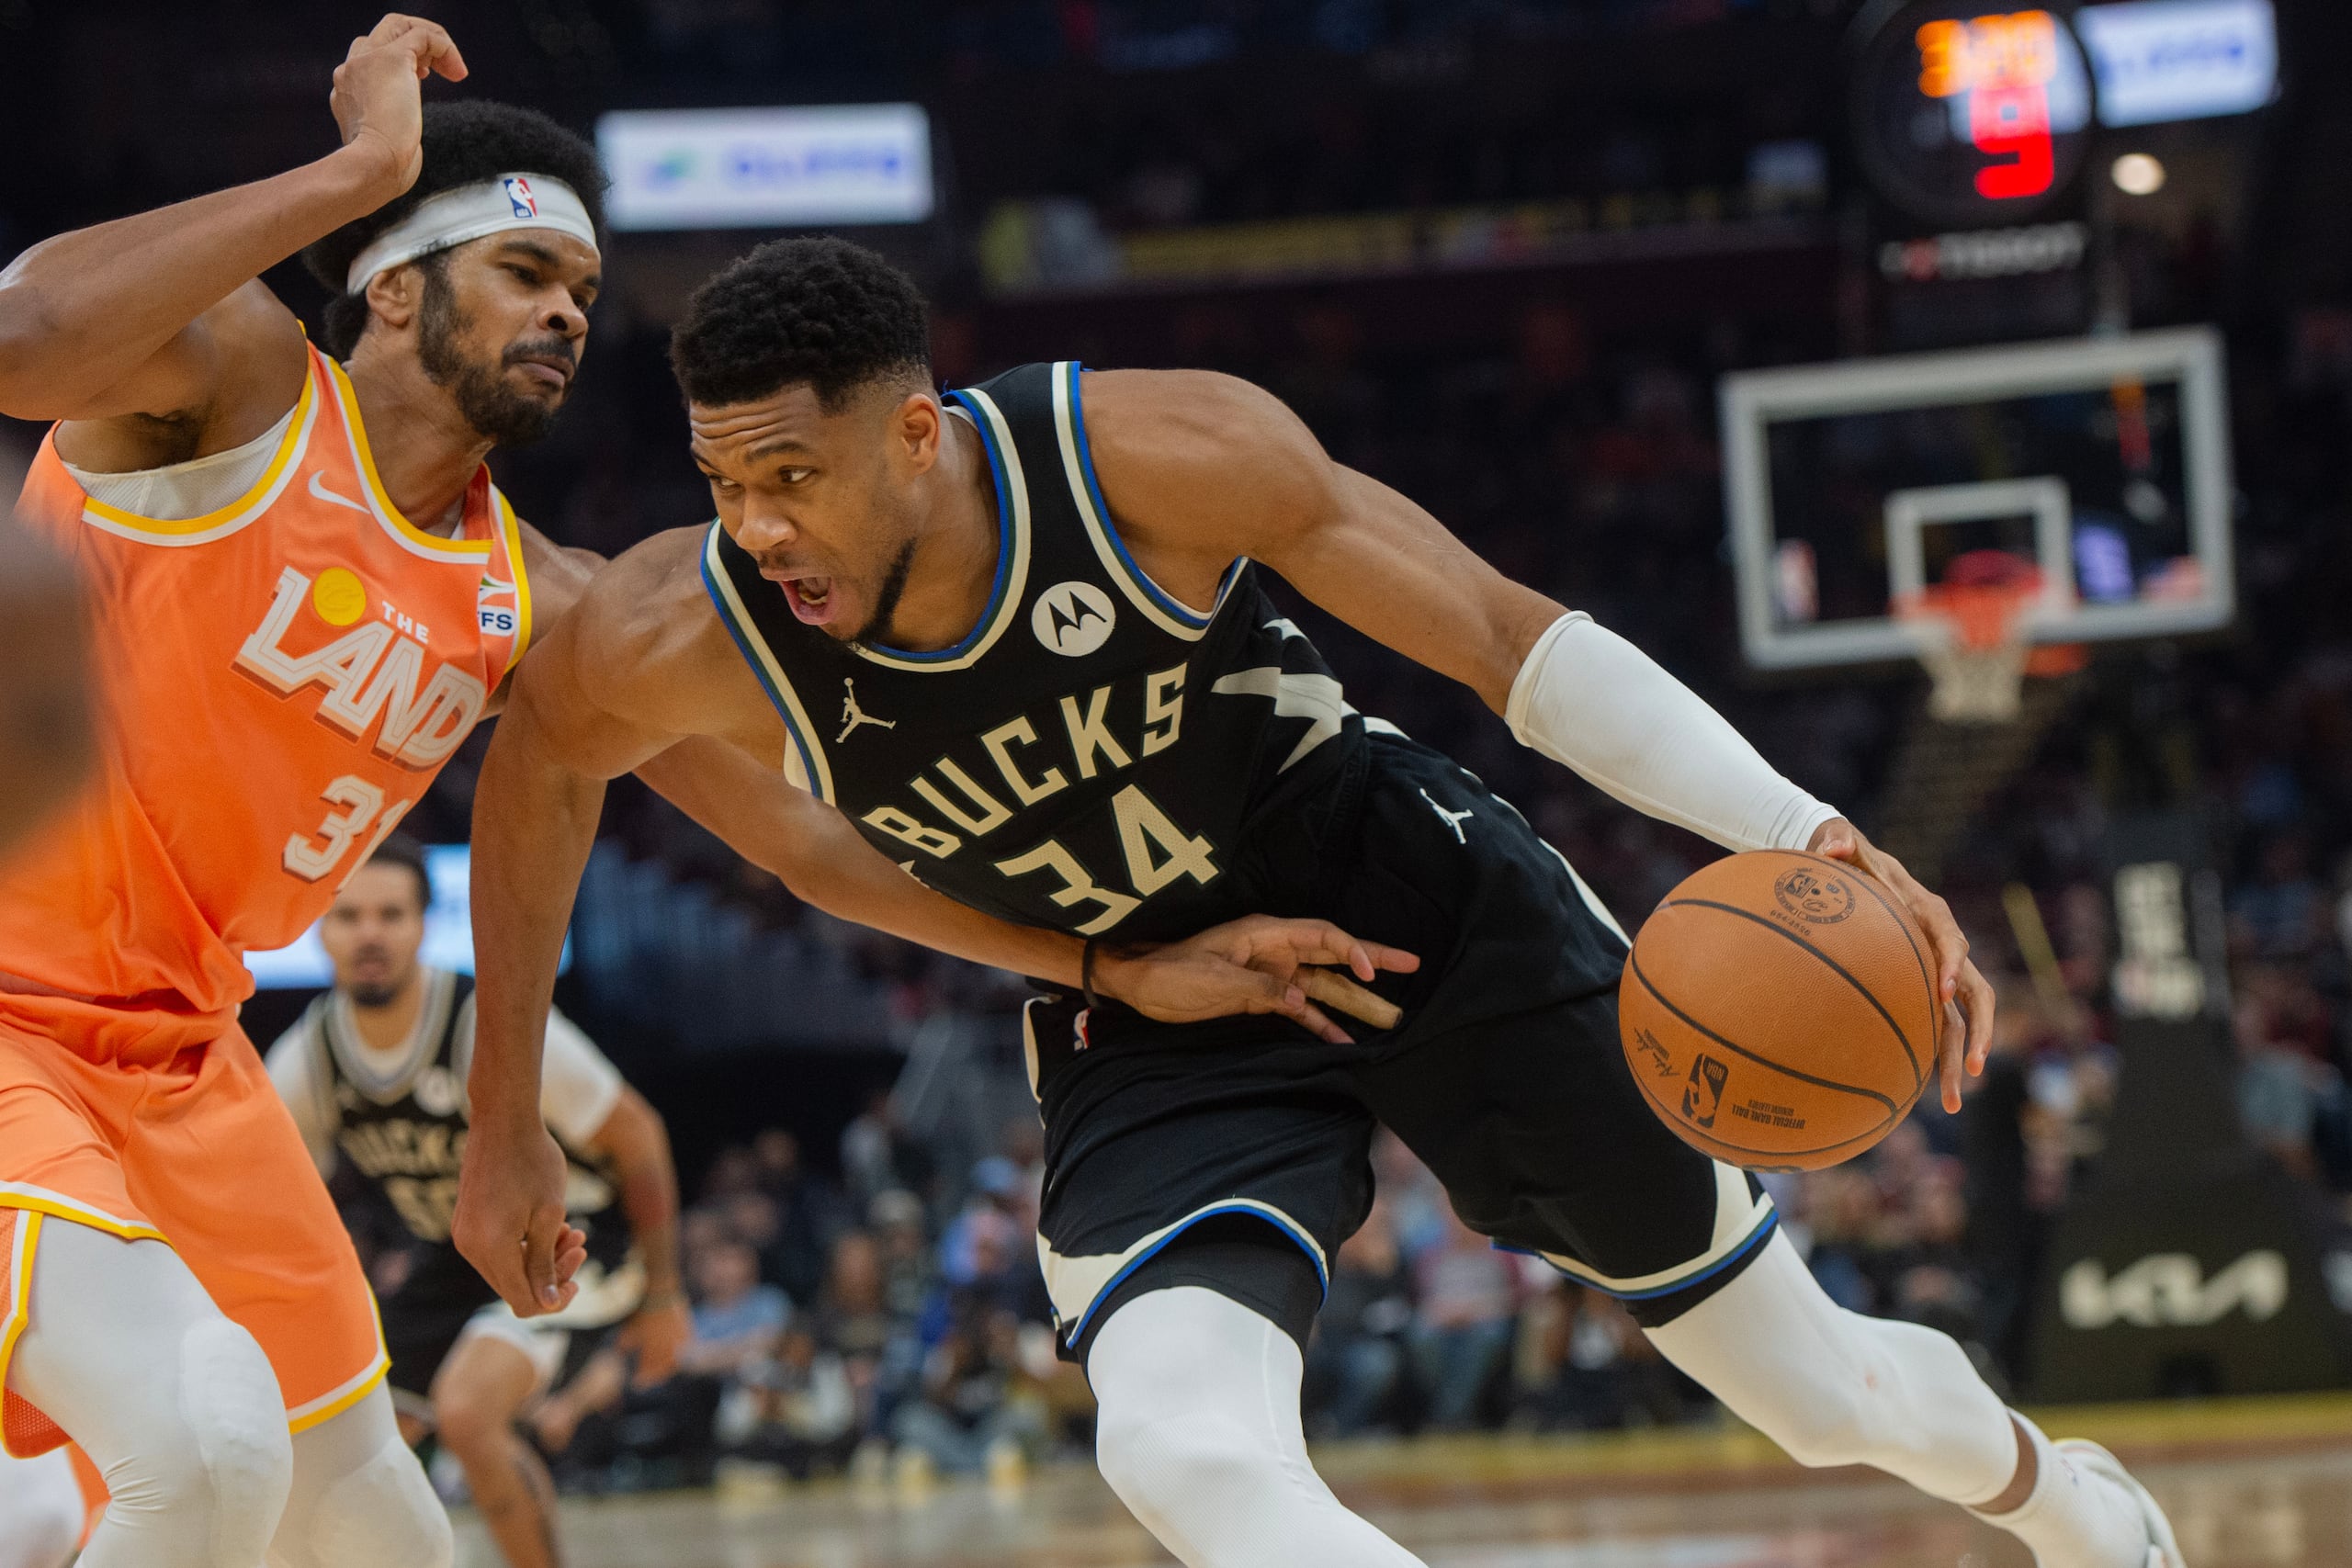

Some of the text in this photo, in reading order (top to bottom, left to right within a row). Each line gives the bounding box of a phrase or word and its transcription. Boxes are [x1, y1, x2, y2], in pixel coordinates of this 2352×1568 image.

[231, 565, 488, 773] LAND
[381, 601, 429, 644] THE
[477, 611, 513, 630] FS
[860, 661, 1188, 860] BUCKS
[993, 784, 1220, 937] 34
